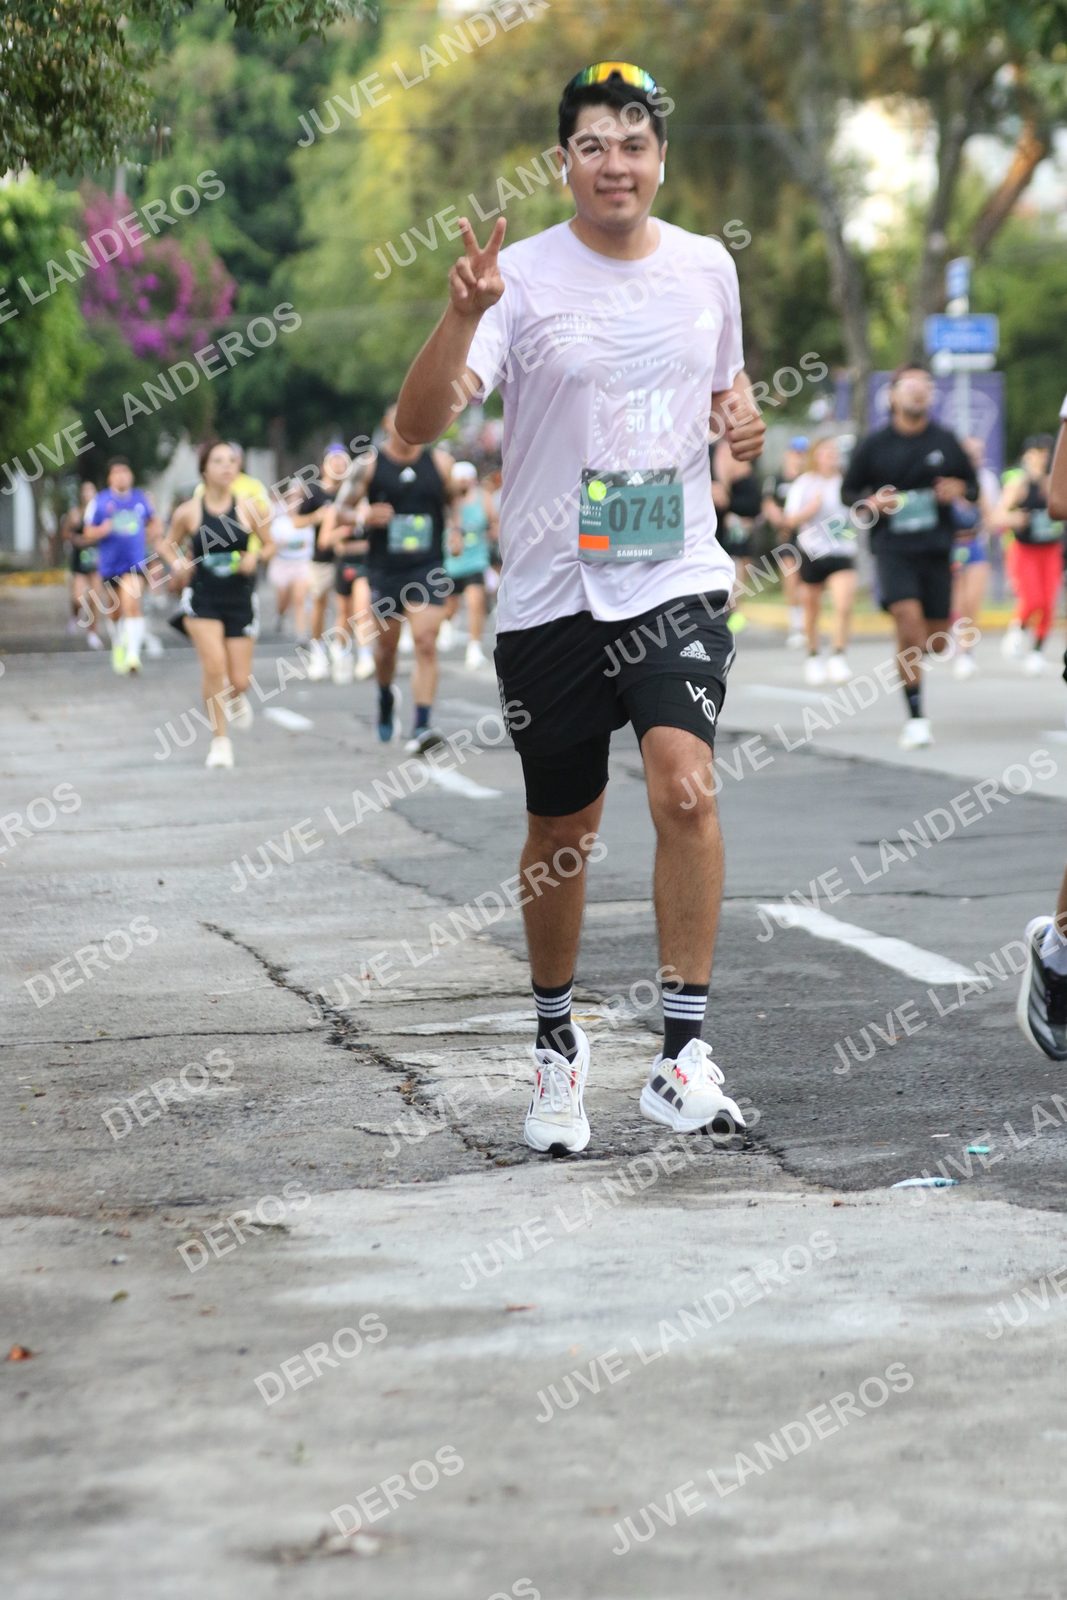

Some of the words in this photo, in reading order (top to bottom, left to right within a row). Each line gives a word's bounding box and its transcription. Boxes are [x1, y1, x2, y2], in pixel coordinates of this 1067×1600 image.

[626, 388, 648, 408] 15
[650, 388, 677, 433] K
[626, 413, 646, 433] 30
[608, 494, 682, 532] 0743
[617, 548, 653, 557] SAMSUNG
[679, 649, 712, 662] adidas
